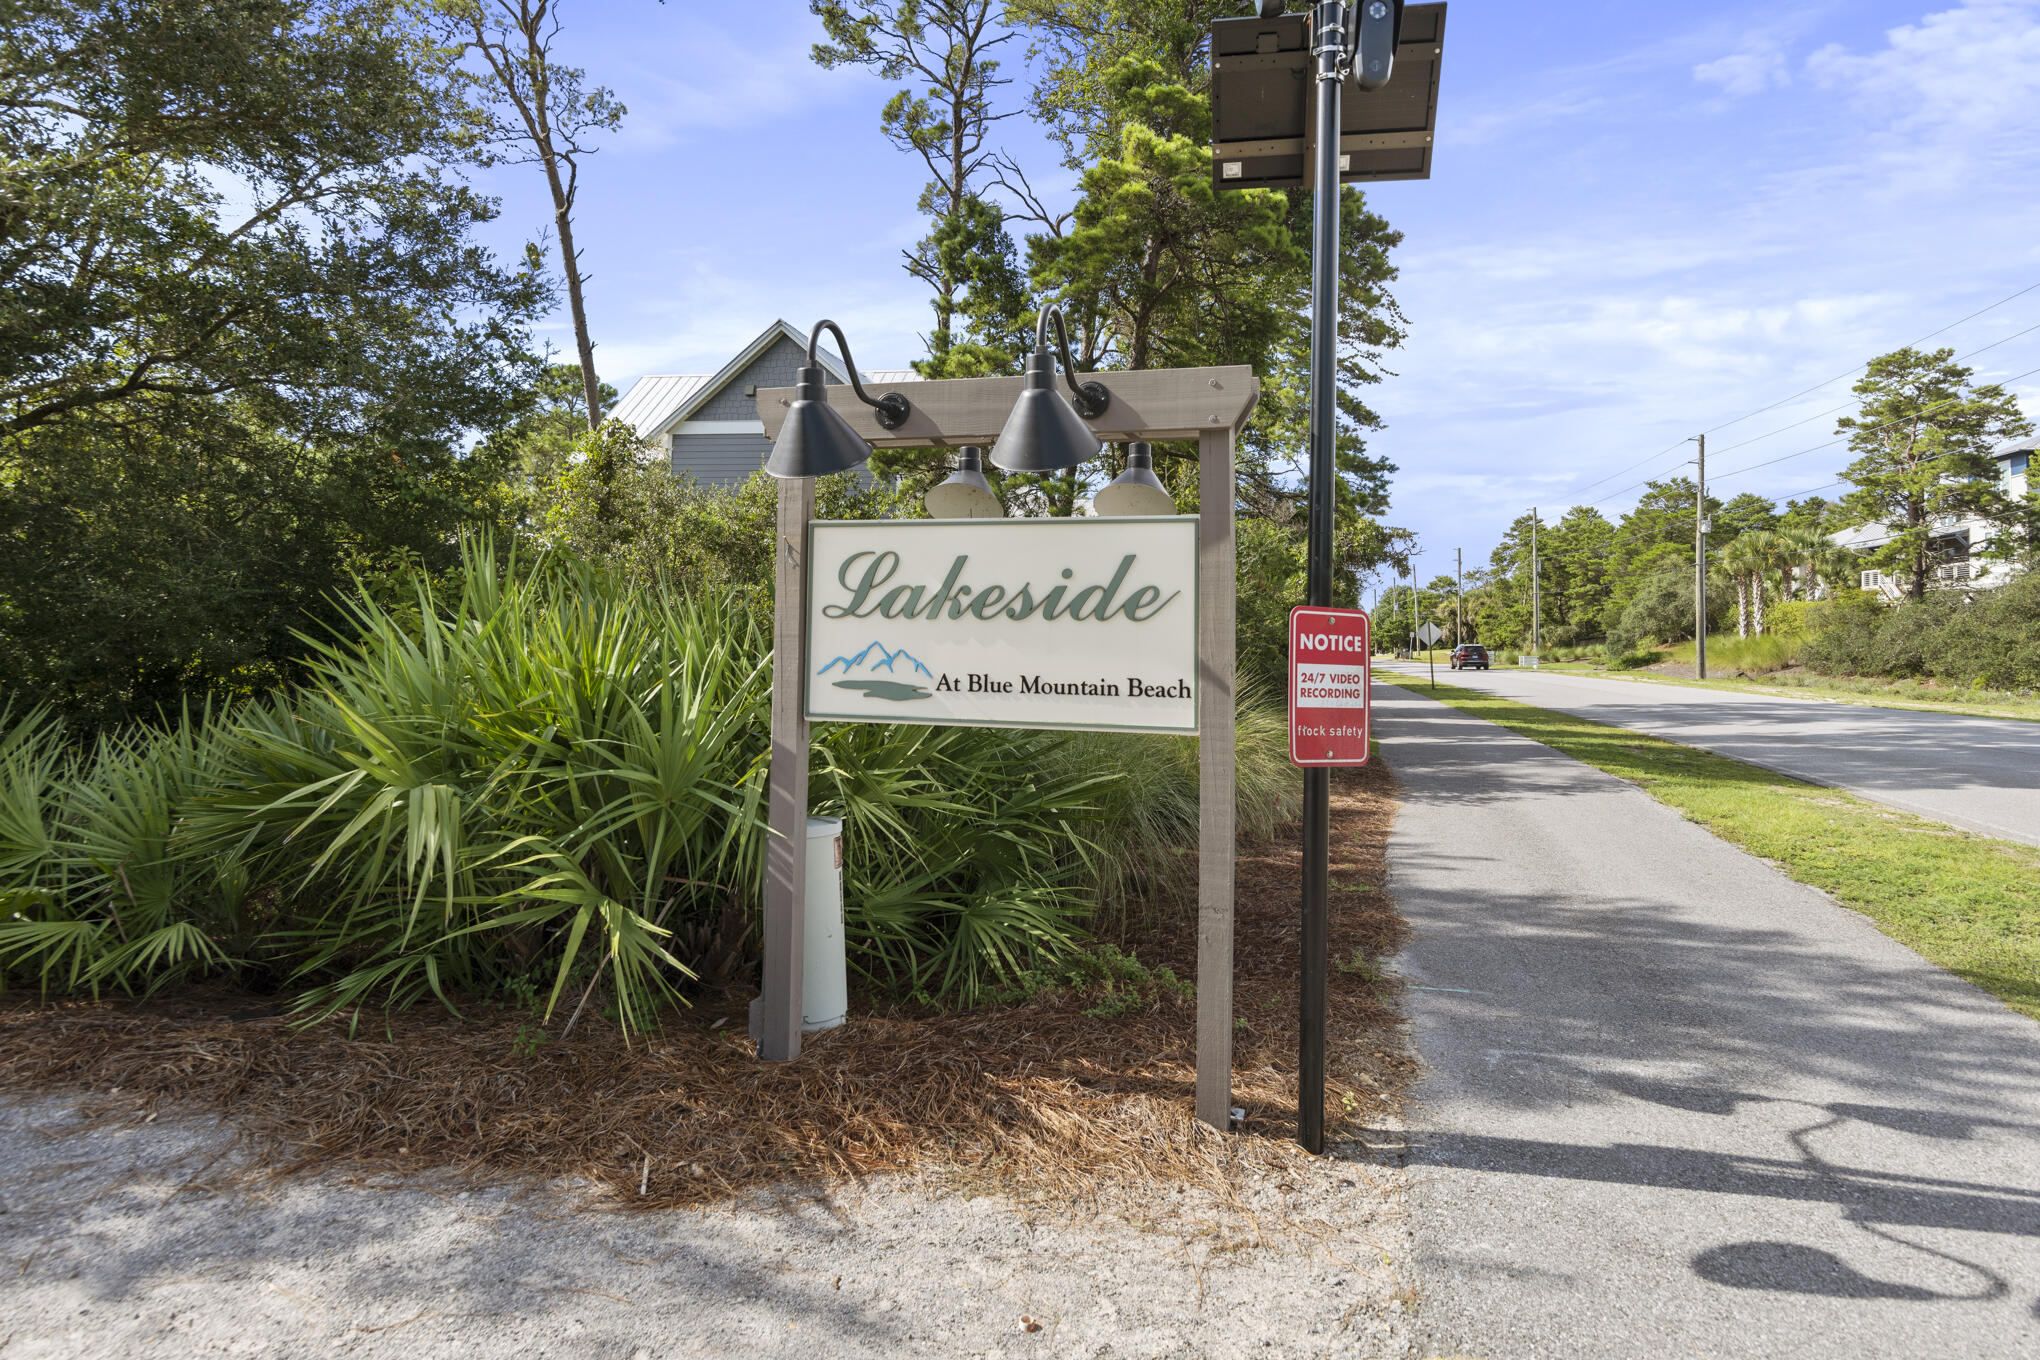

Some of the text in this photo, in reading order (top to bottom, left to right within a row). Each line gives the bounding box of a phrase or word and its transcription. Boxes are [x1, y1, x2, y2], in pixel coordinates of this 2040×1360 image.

[822, 551, 1182, 622] Lakeside
[1300, 633, 1361, 652] NOTICE
[935, 673, 1193, 699] At Blue Mountain Beach
[1300, 673, 1360, 684] 24/7 VIDEO
[1300, 688, 1360, 699] RECORDING
[1329, 725, 1362, 738] safety
